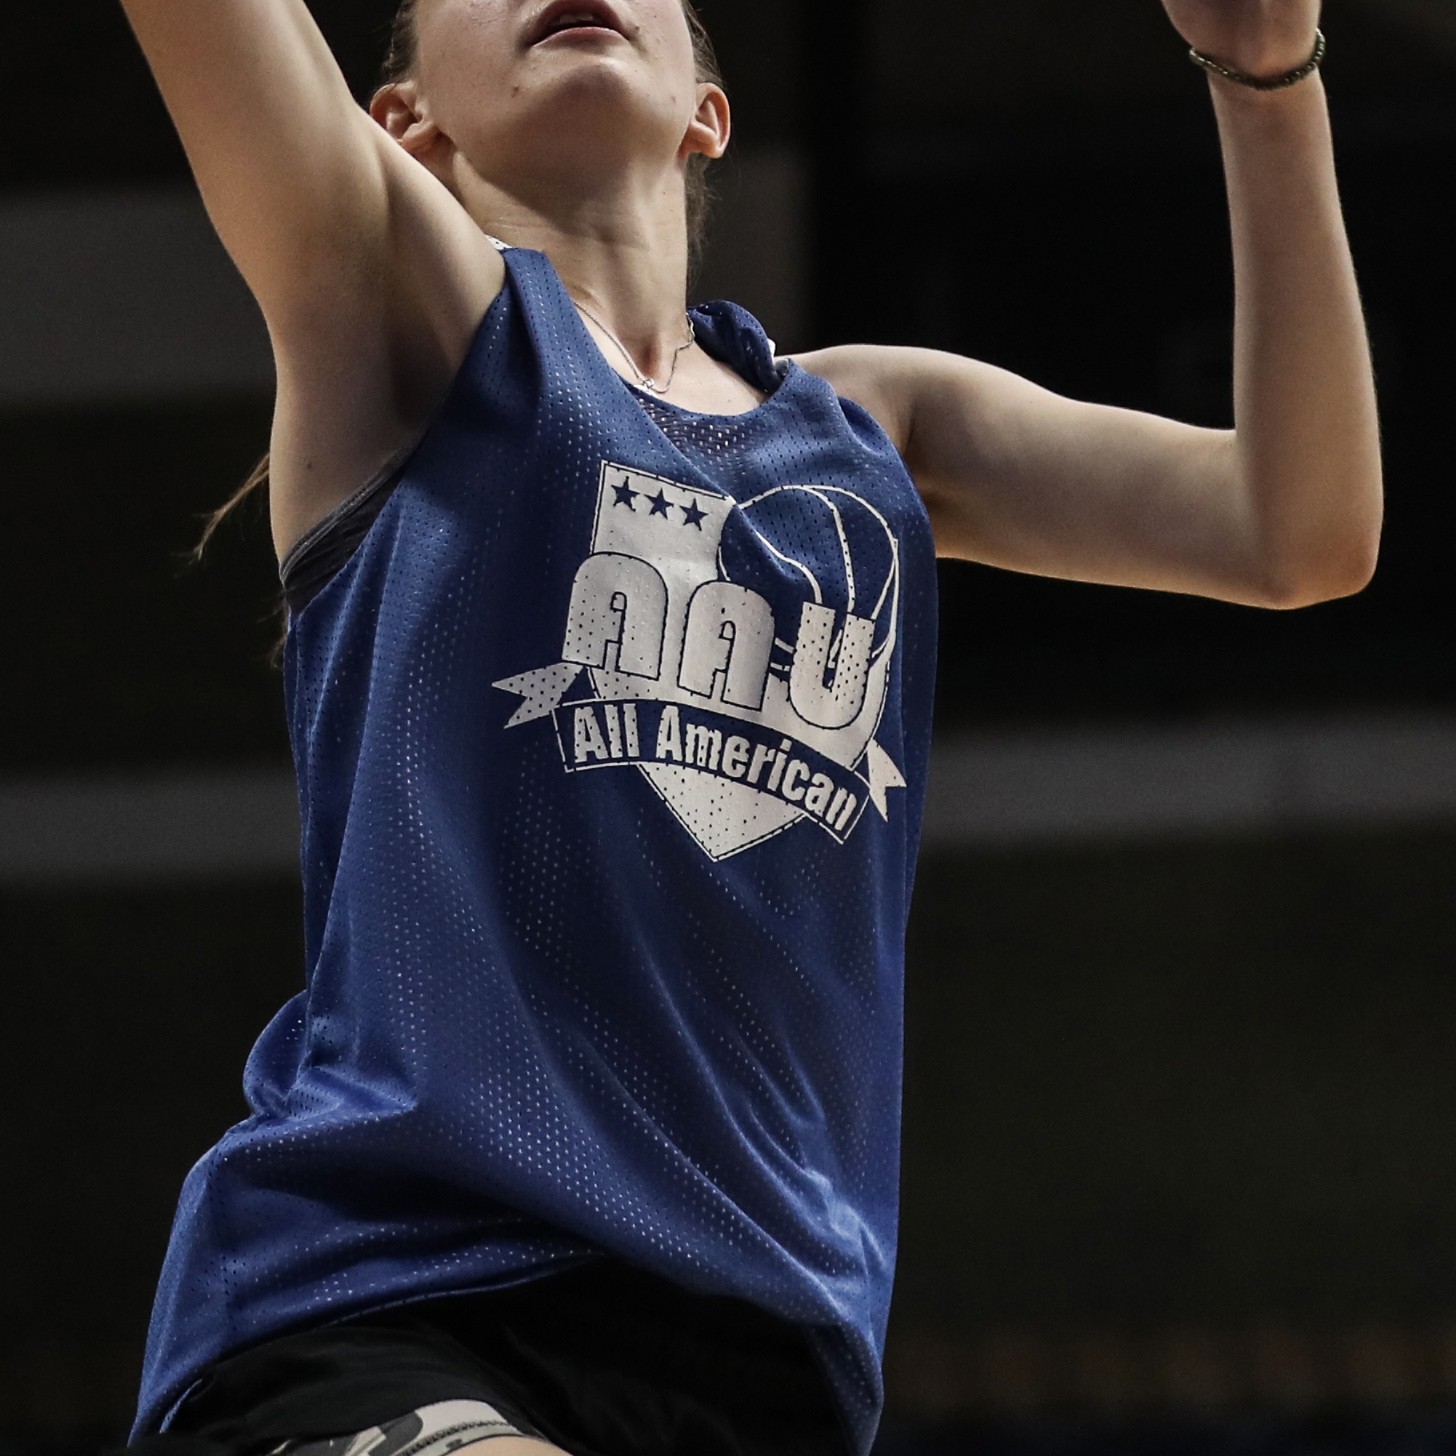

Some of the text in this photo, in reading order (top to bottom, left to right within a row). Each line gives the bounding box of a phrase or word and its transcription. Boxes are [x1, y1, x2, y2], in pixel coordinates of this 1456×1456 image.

[562, 552, 875, 730] AAU
[574, 703, 858, 832] All American
